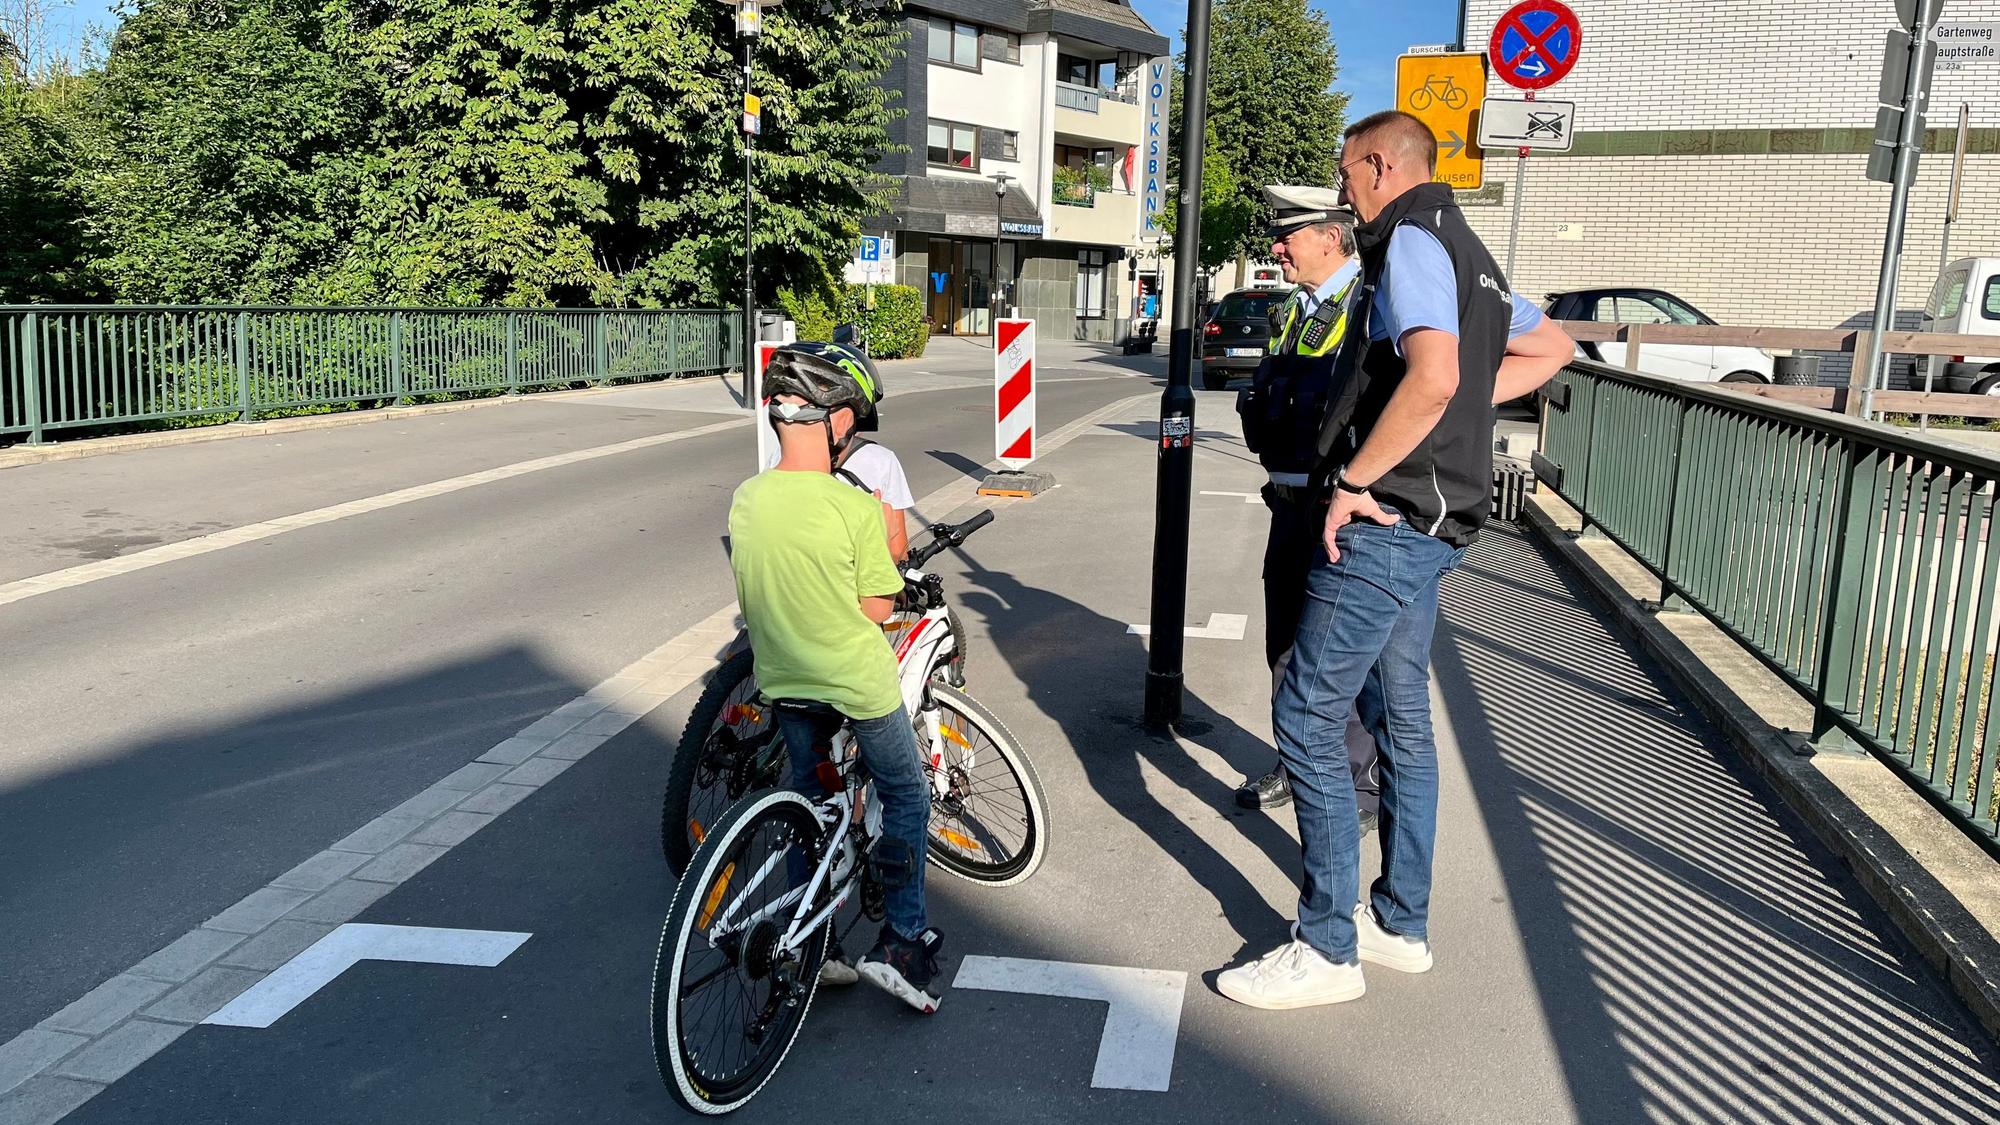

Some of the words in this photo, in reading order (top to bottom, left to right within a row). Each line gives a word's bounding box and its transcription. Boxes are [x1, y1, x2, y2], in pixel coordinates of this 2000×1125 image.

[1937, 26, 1993, 39] Gartenweg
[1410, 45, 1457, 54] BURSCHEIDE
[1936, 45, 1995, 59] auptstraße
[1945, 62, 1961, 70] 23a
[1145, 63, 1164, 231] VOLKSBANK
[1558, 224, 1569, 232] 23
